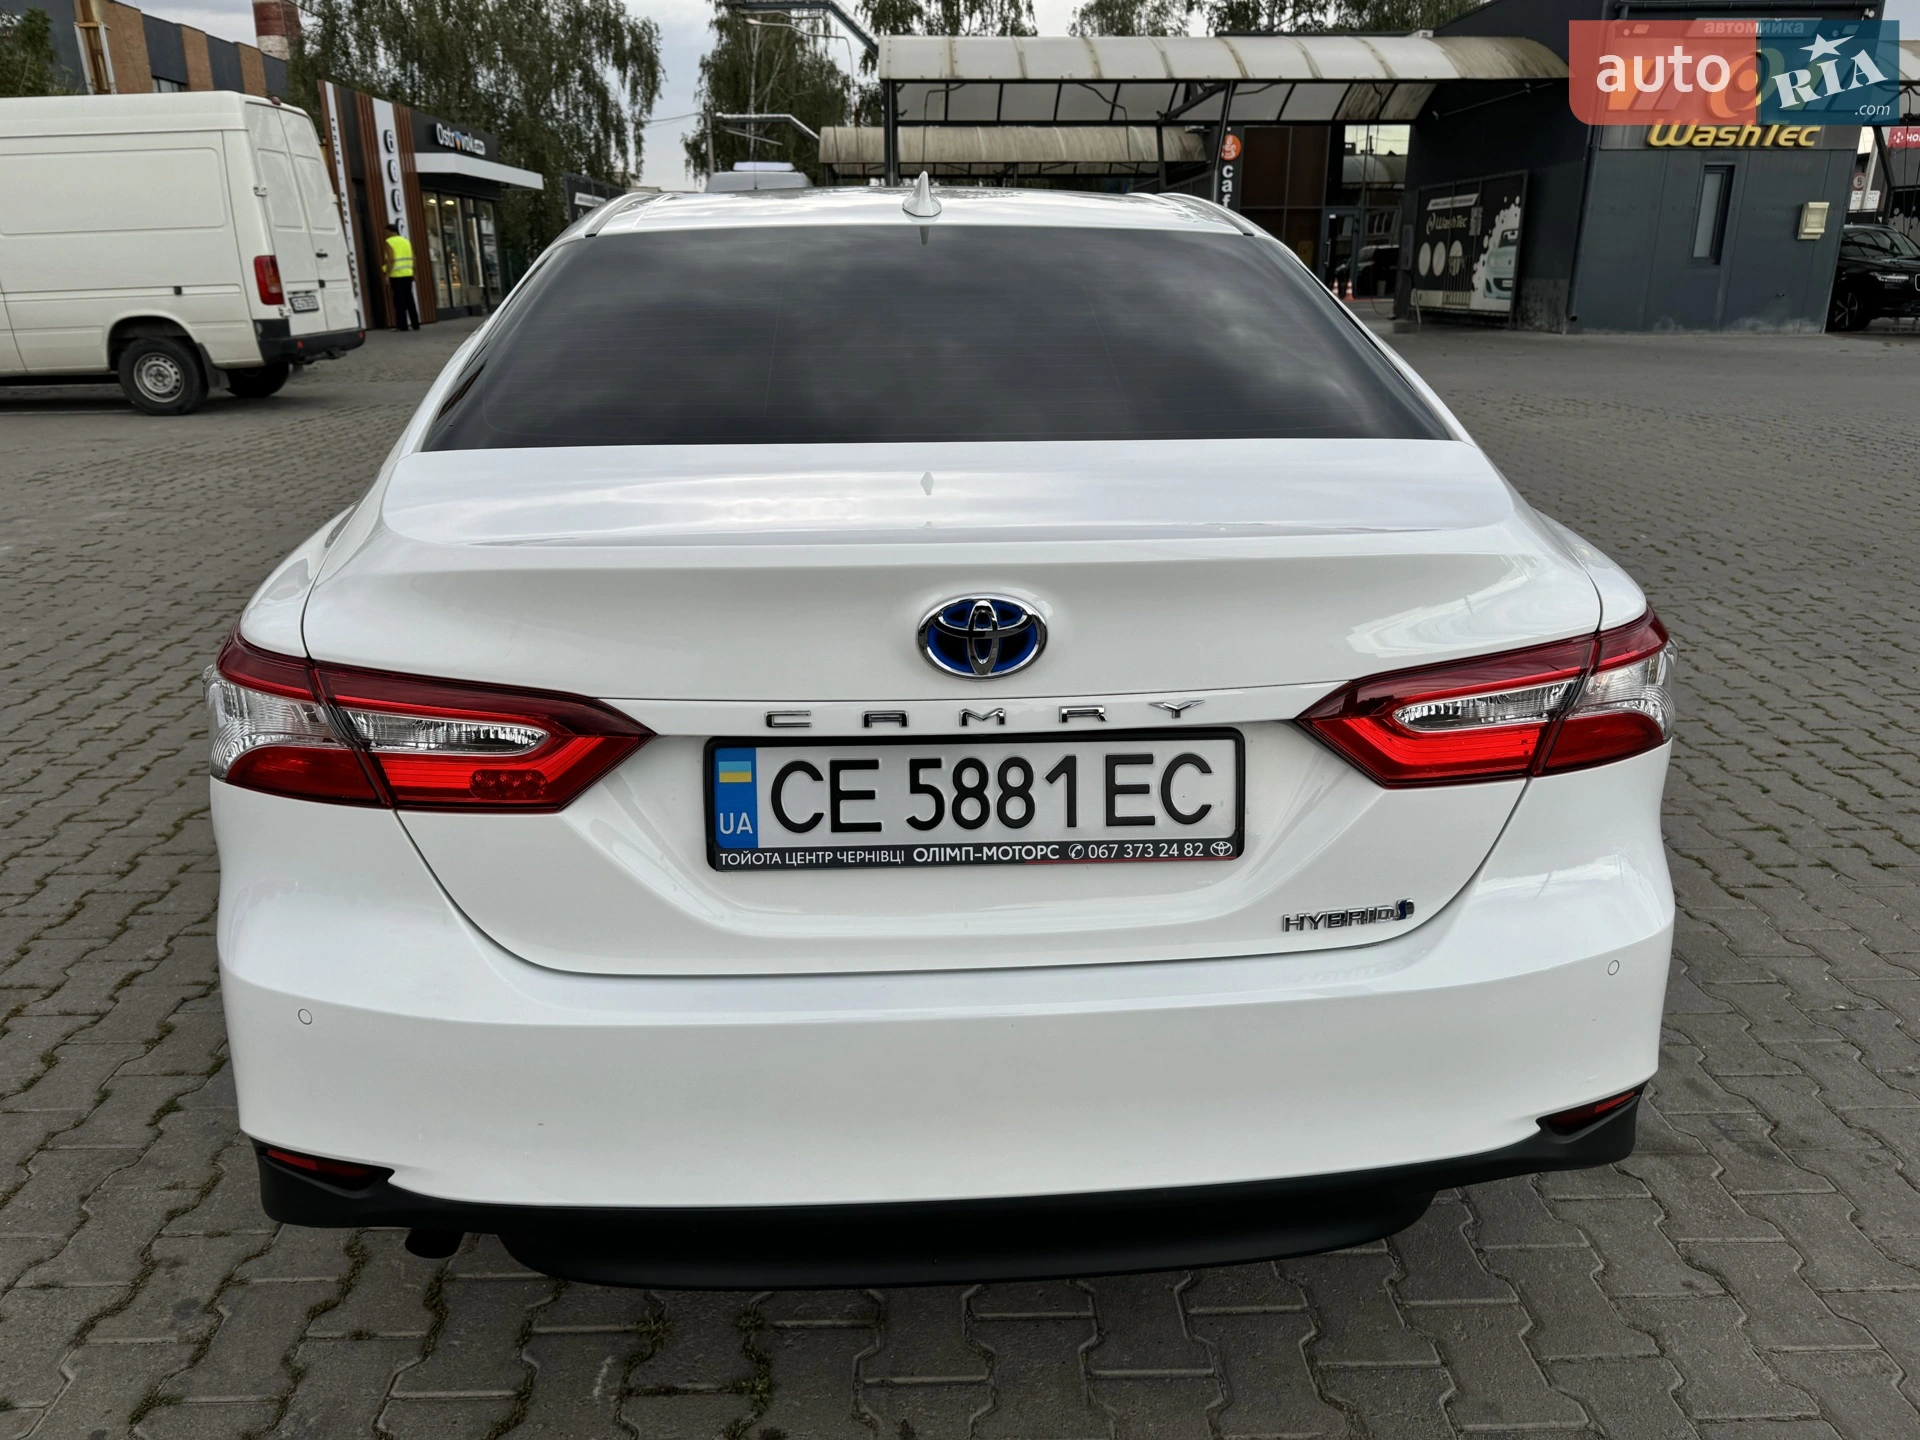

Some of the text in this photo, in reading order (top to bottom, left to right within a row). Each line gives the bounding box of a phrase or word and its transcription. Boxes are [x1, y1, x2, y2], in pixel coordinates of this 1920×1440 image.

[1704, 18, 1804, 34] автомийка
[1648, 119, 1822, 147] WashTec
[1906, 133, 1920, 142] НО
[765, 700, 1205, 728] CAMRY
[771, 753, 1213, 834] CE 5881 EC
[719, 812, 753, 835] UA
[720, 842, 1204, 866] ТОЙОТА ЦЕНТР ЧЕРНІВЦІ ОЛІМП-МОТОРС 067 373 24 82
[1282, 905, 1395, 932] HYBRID
